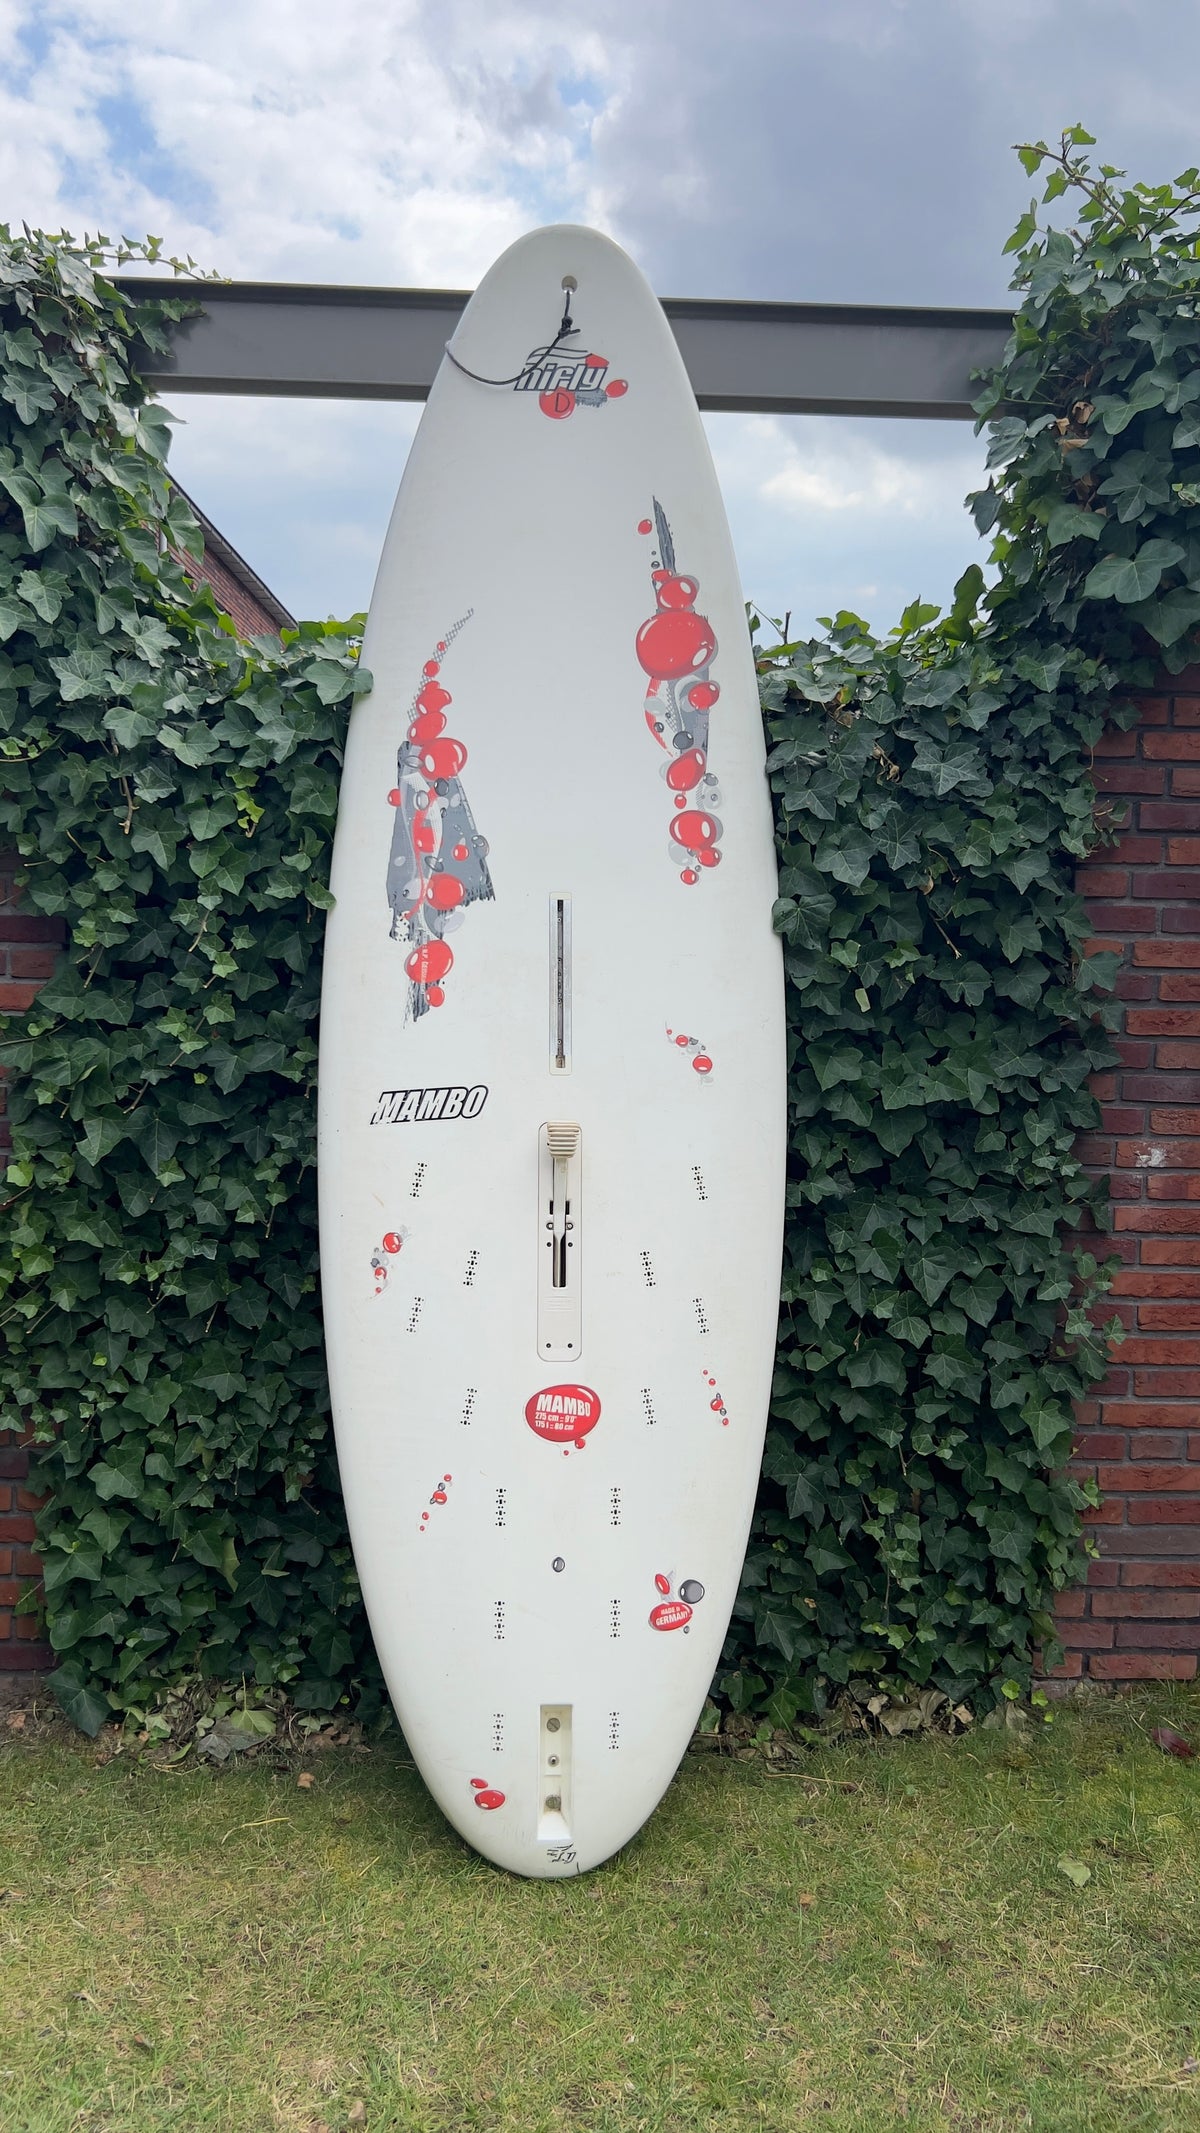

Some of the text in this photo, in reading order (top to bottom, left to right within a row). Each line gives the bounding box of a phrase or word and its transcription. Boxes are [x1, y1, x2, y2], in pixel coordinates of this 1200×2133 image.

[555, 392, 571, 413] D
[370, 1085, 489, 1125] MAMBO
[536, 1394, 591, 1417] MAMBO
[535, 1411, 547, 1421] 275
[547, 1414, 560, 1422] cm
[535, 1420, 546, 1429] 175
[655, 1610, 689, 1626] GERMANY
[660, 1606, 675, 1615] MADE
